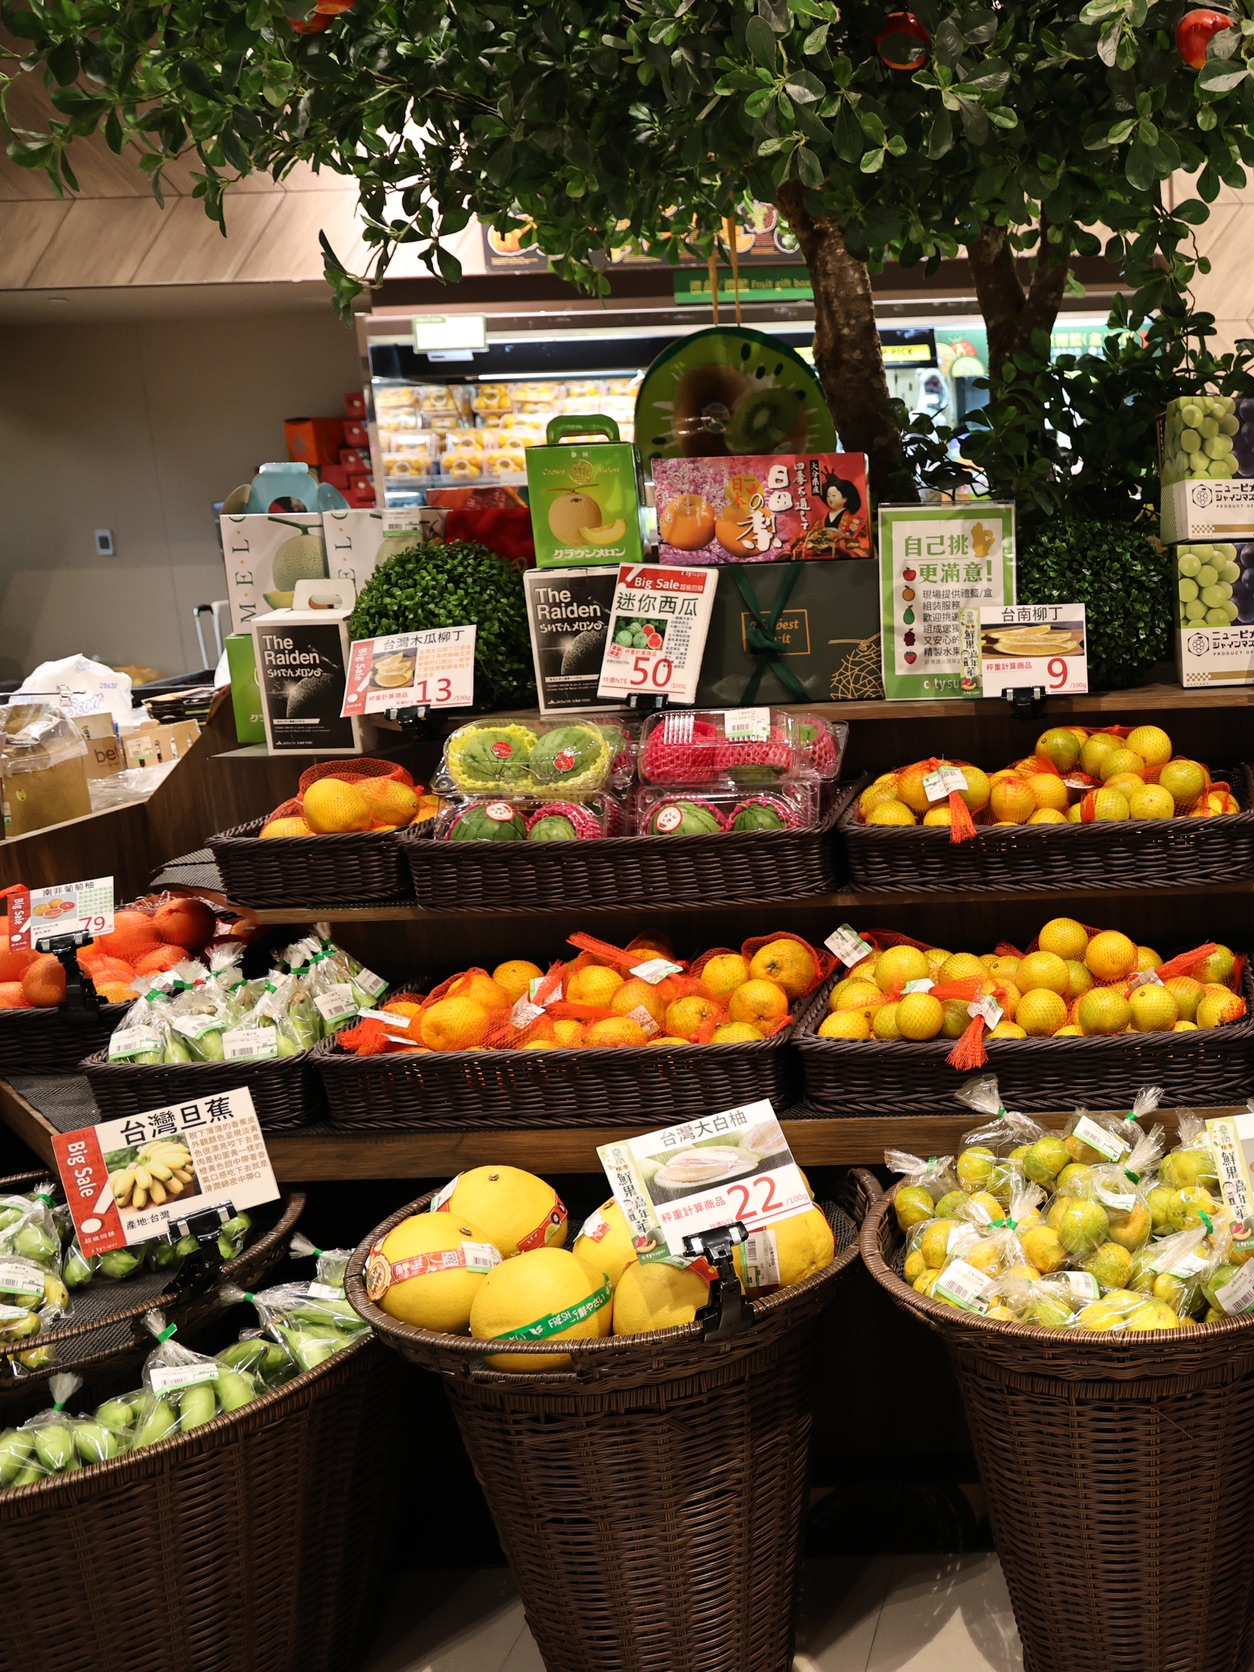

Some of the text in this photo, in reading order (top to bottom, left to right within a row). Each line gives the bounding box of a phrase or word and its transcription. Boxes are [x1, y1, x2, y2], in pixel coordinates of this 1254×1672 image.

[553, 547, 626, 559] クラウンメロン
[904, 535, 969, 557] 自己挑
[918, 560, 993, 584] 更滿意!
[634, 577, 680, 590] Big Sale
[535, 588, 571, 602] The
[615, 591, 699, 616] 迷你西瓜
[922, 601, 961, 611] 組裝服務
[537, 604, 600, 620] Raiden
[1001, 606, 1063, 622] 台南柳丁
[262, 635, 293, 650] The
[384, 630, 465, 650] 台灣木瓜柳丁
[264, 650, 320, 666] Raiden
[353, 648, 368, 682] Big Sale
[630, 657, 673, 687] 50
[1047, 657, 1068, 689] 9
[417, 678, 452, 704] 13
[66, 692, 104, 716] Scott
[43, 881, 94, 896] 南非葡萄柚
[13, 898, 24, 925] Big Sale
[79, 916, 105, 932] 79
[120, 1096, 234, 1145] 台灣旦蕉
[660, 1110, 748, 1148] 台灣大白柚
[67, 1141, 97, 1198] Big Sale
[726, 1176, 784, 1221] 22
[785, 1191, 808, 1210] /100g
[661, 1196, 726, 1224] 秤重計算商品
[548, 1311, 571, 1328] FRESH
